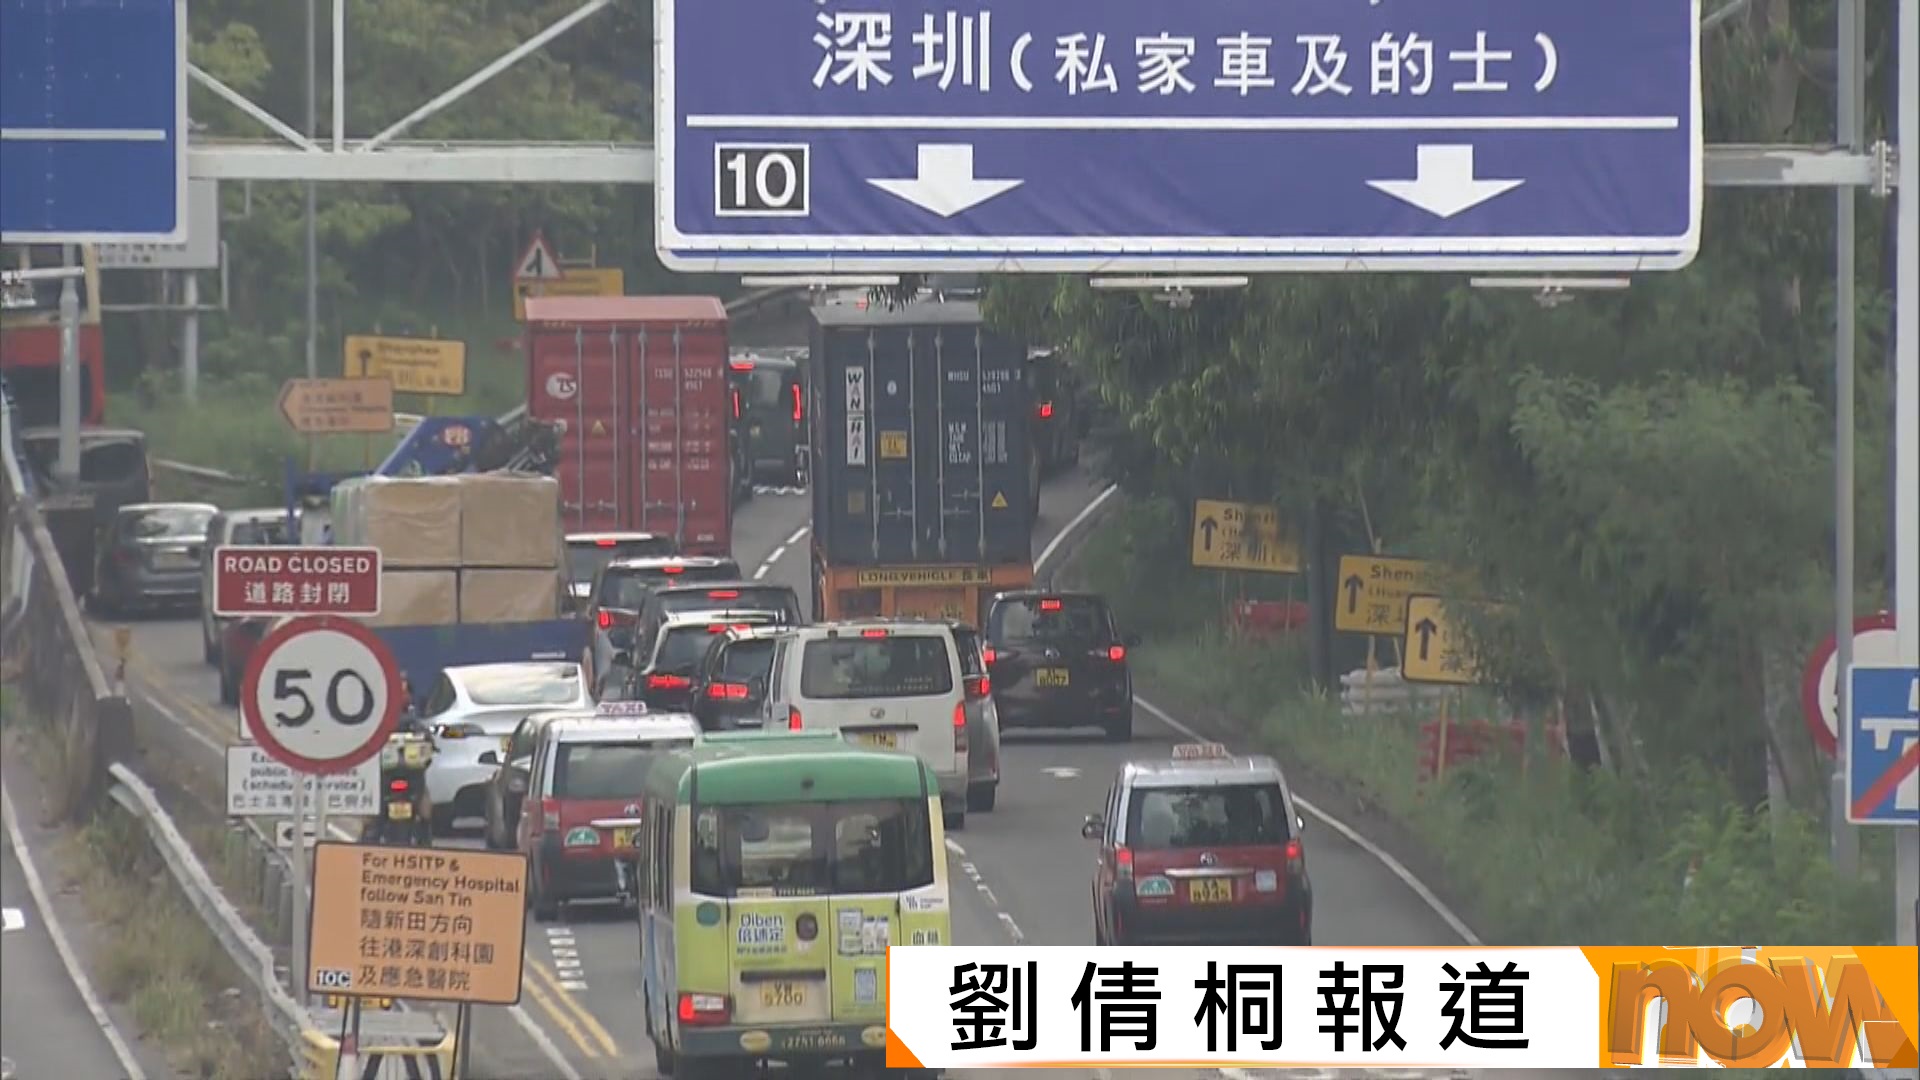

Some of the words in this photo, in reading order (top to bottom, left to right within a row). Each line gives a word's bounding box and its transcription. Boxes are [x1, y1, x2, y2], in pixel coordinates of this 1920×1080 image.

[812, 9, 1560, 95] 深圳(私家車及的士)
[726, 152, 797, 207] 10
[224, 556, 282, 574] ROAD
[287, 555, 370, 575] CLOSED
[244, 581, 350, 605] 道路封閉
[273, 668, 375, 728] 50
[362, 852, 388, 868] For
[393, 855, 445, 870] HSITP
[449, 858, 460, 872] &
[361, 869, 449, 890] Emergency
[454, 875, 519, 894] Hospital
[360, 886, 409, 905] follow
[413, 890, 444, 906] San
[450, 892, 472, 907] Tin
